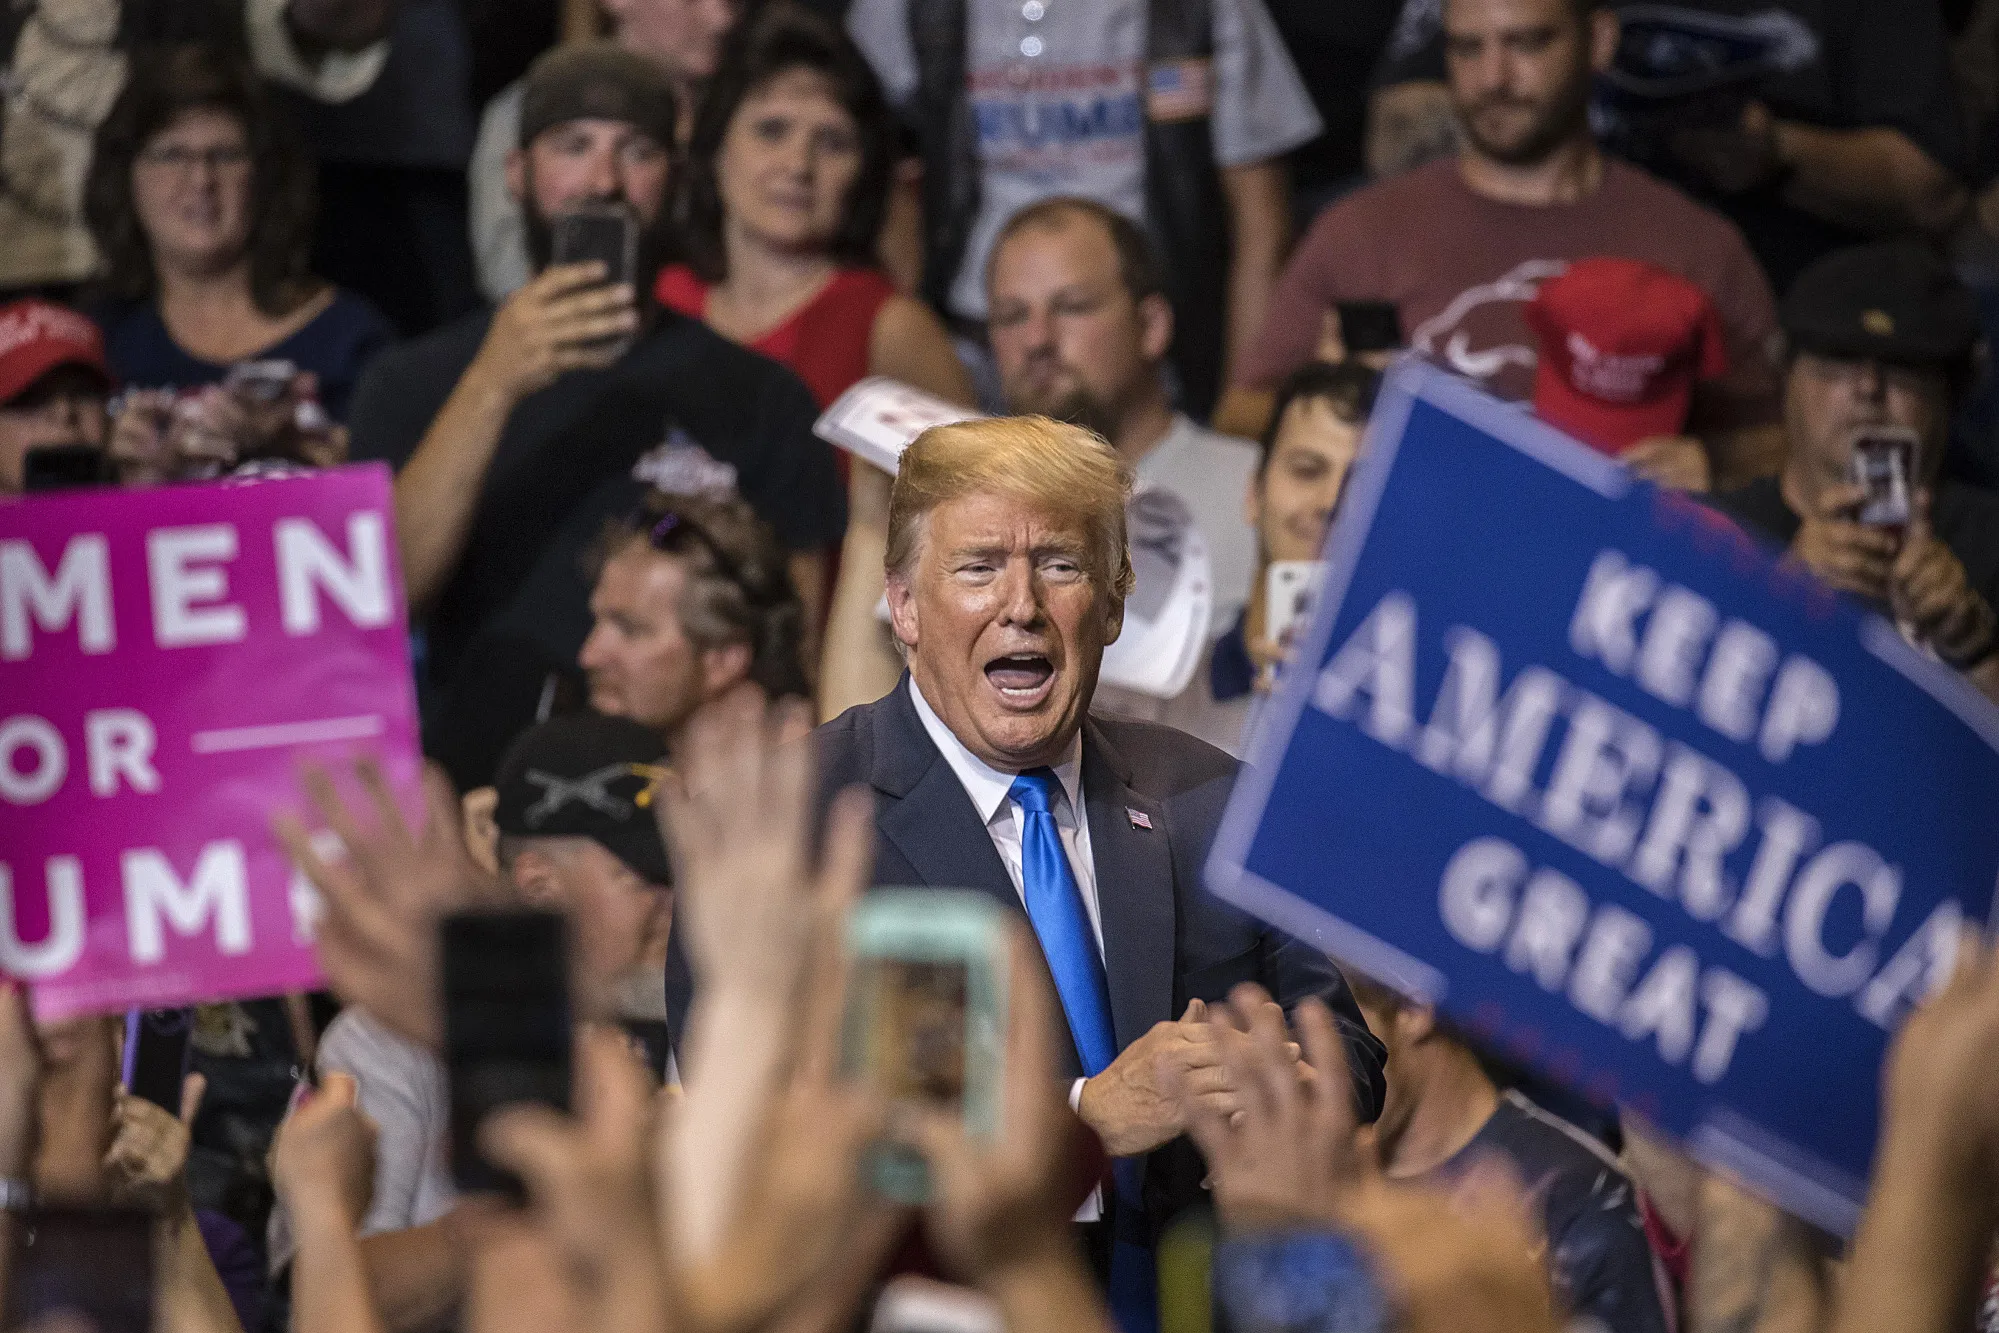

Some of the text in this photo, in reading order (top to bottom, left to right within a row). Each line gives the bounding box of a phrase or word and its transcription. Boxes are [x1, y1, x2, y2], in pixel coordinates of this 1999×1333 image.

[0, 511, 395, 662] MEN
[1569, 549, 1842, 763] KEEP
[0, 708, 161, 804] OR
[1305, 590, 1964, 1032] AMERICA
[1438, 836, 1767, 1083] GREAT
